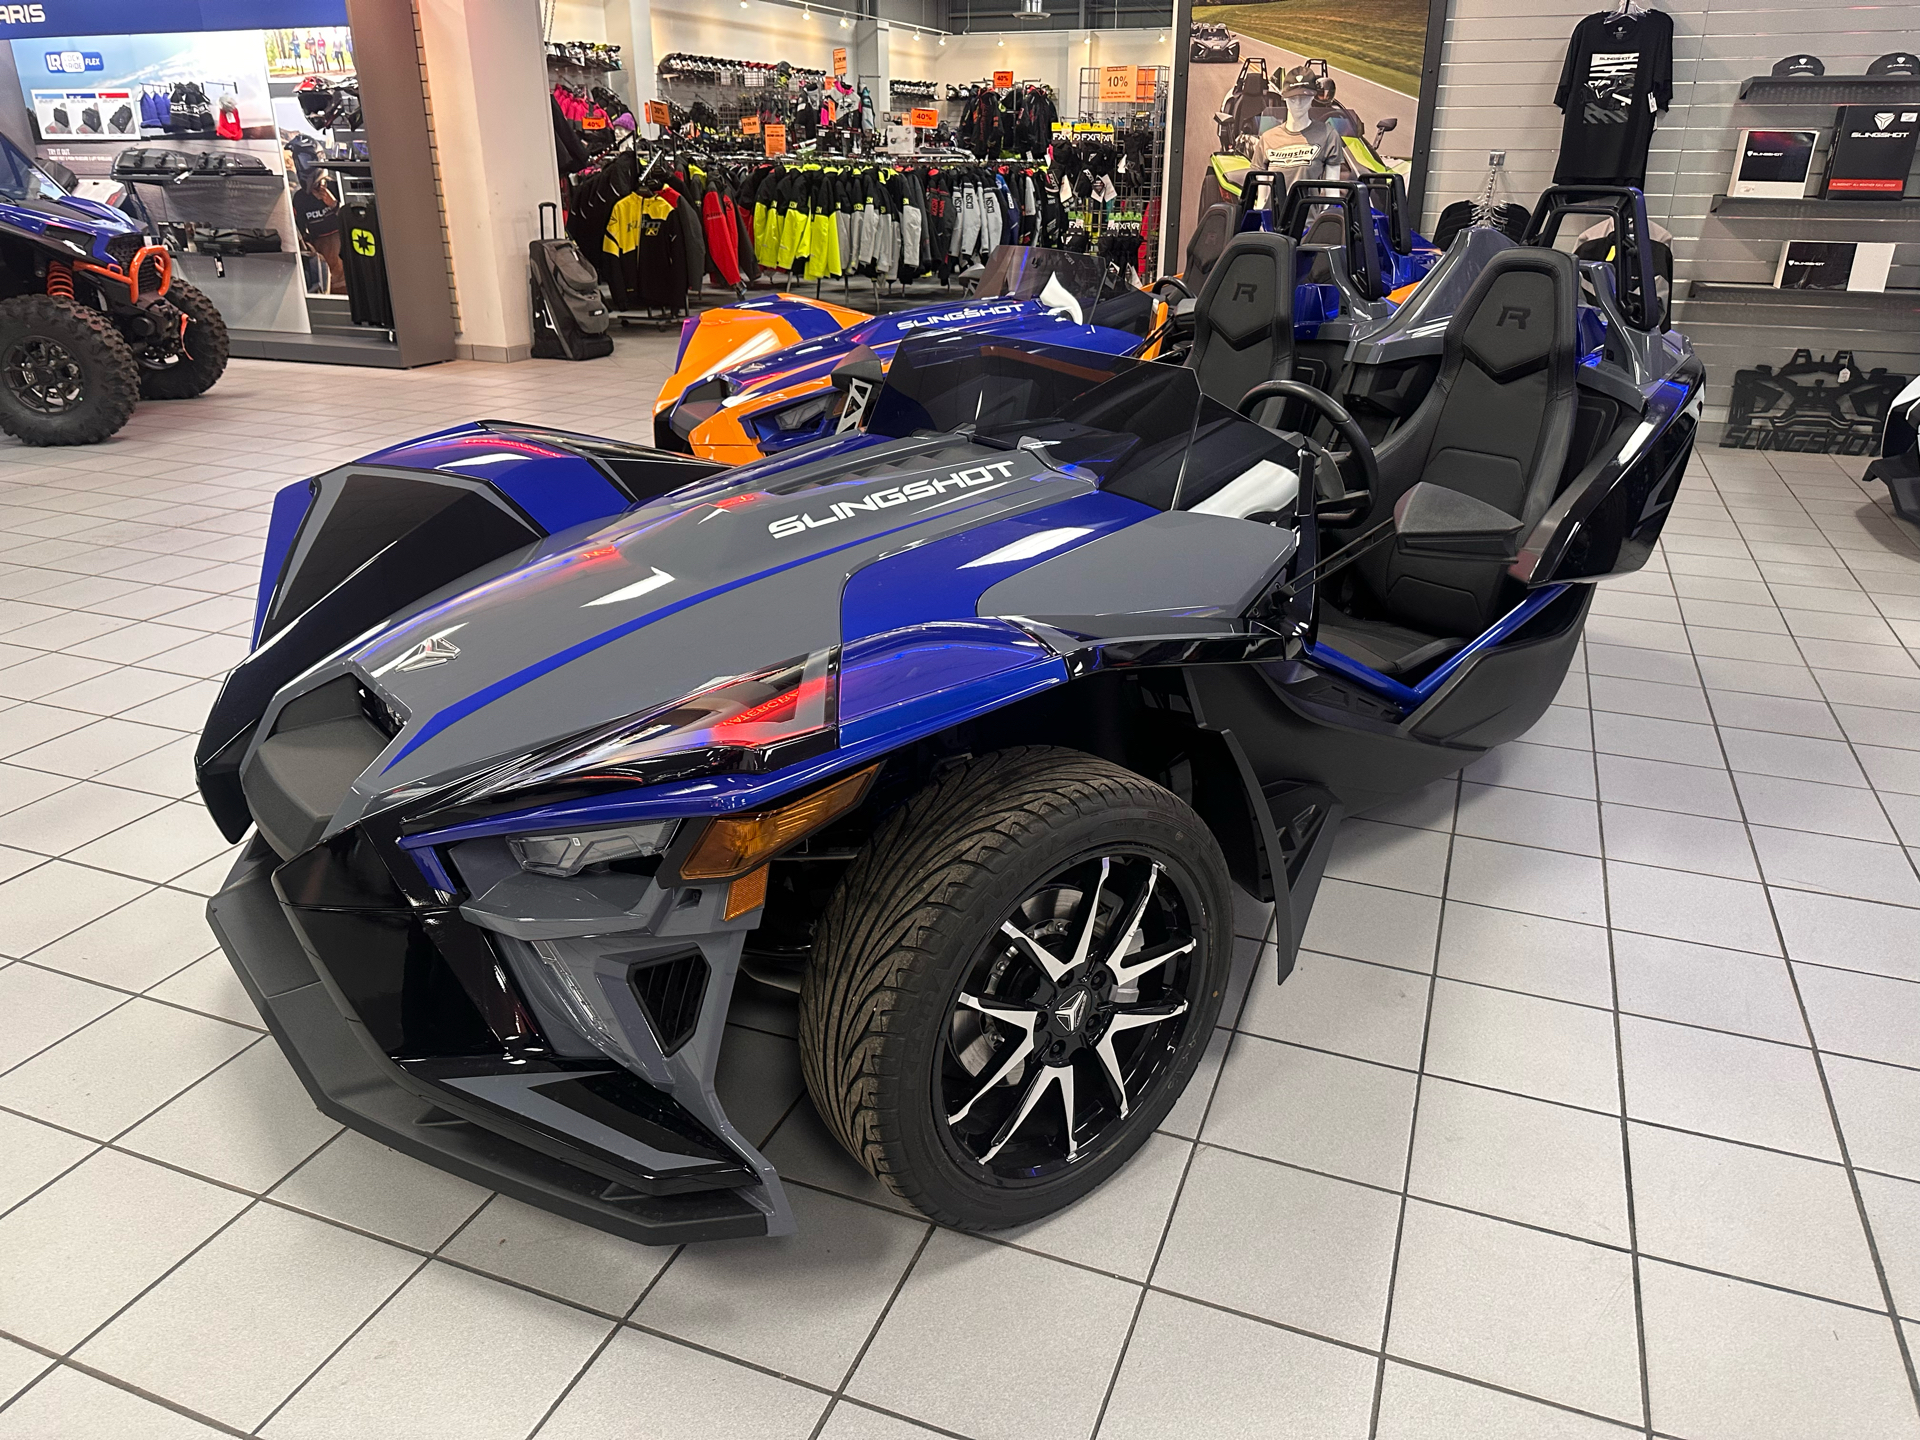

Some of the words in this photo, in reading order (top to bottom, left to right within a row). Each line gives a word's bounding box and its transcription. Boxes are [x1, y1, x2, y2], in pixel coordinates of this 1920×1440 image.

[1107, 75, 1128, 88] 10%
[654, 106, 665, 116] 30%
[1081, 132, 1101, 141] FXR
[1269, 148, 1314, 159] Slingshot
[1232, 282, 1258, 303] R
[896, 303, 1025, 330] SLINGSHOT
[1496, 305, 1531, 330] R
[768, 460, 1014, 540] SLINGSHOT
